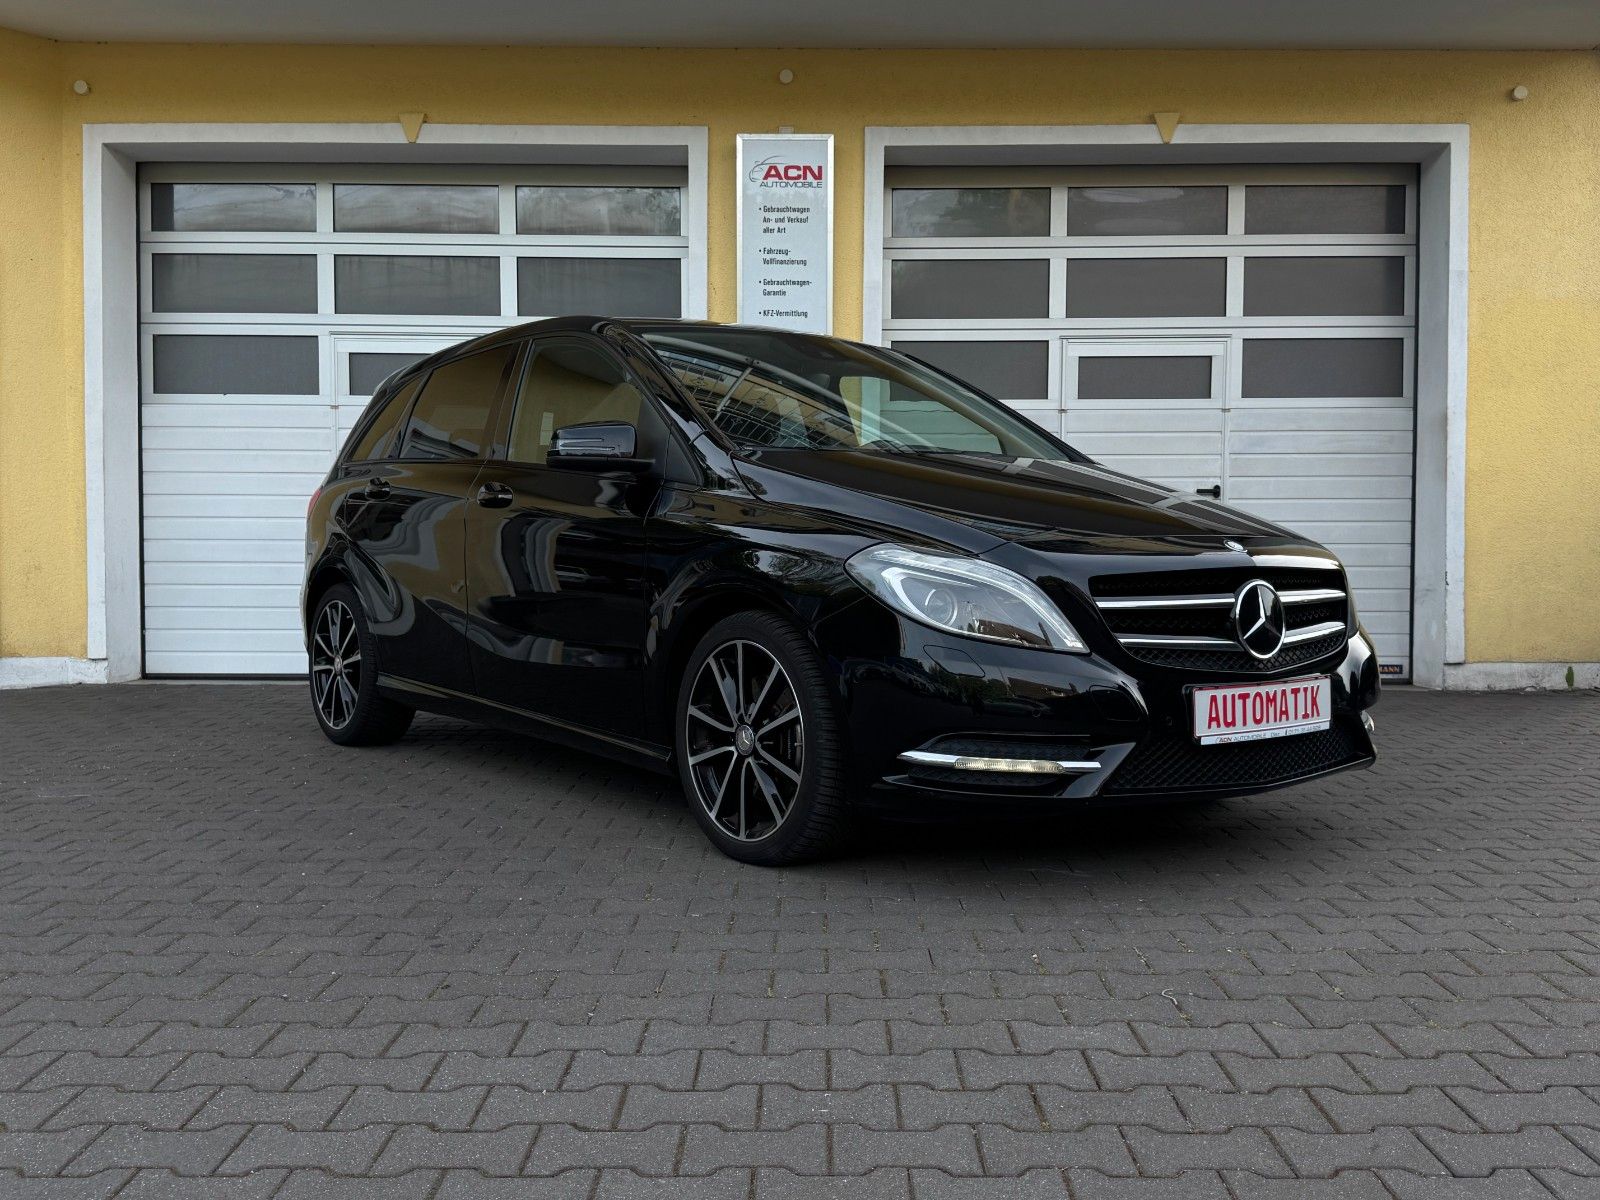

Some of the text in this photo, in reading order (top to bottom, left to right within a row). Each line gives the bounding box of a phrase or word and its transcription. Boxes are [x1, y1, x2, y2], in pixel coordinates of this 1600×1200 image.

[762, 165, 823, 181] ACN
[763, 205, 811, 215] Gebrauchtwagen
[763, 247, 791, 256] Fahrzeug-
[762, 258, 807, 266] Vollfinanzierung
[763, 278, 812, 287] Gebrauchtwagen-
[763, 310, 808, 318] KFZ-Vermittlung
[1207, 684, 1320, 729] AUTOMATIK
